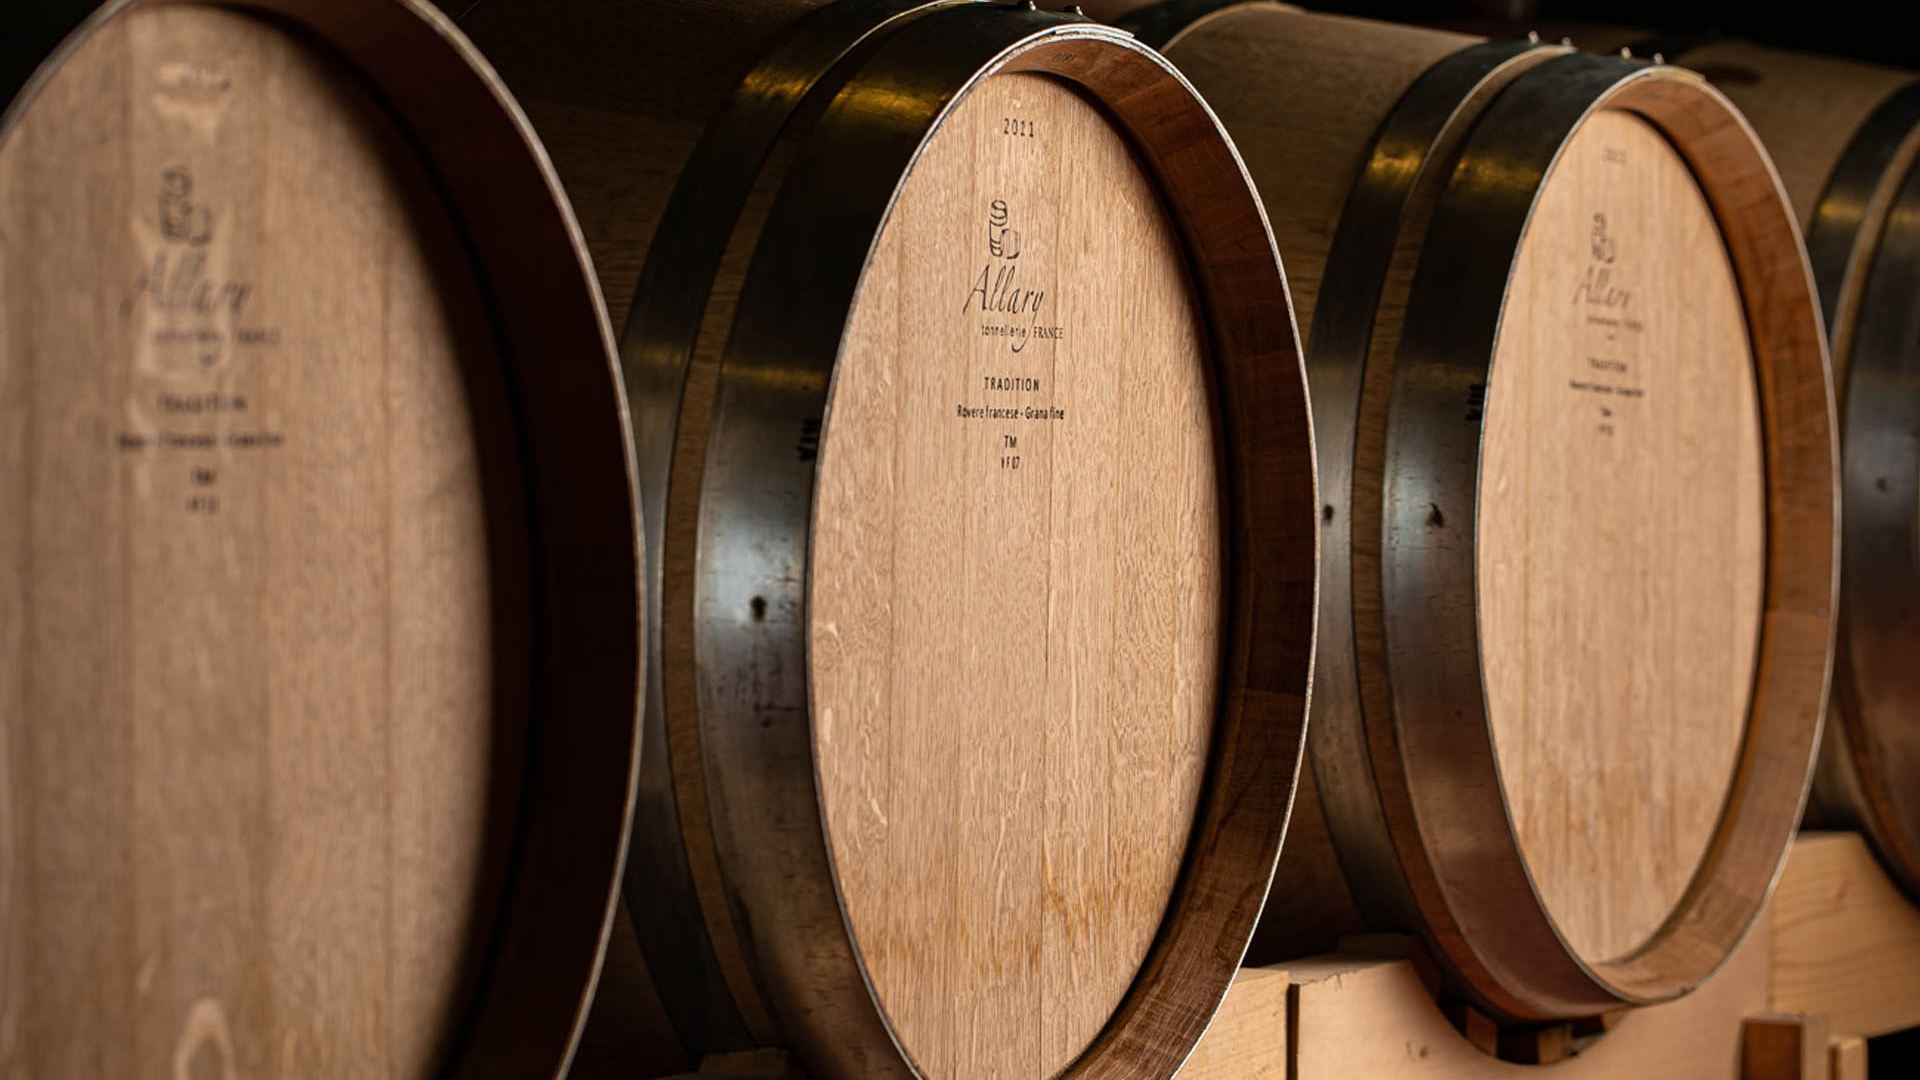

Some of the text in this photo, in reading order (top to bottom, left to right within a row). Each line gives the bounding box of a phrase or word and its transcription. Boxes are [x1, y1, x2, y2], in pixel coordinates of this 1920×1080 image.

[962, 264, 1044, 353] Allary
[1033, 325, 1064, 339] FRANCE
[984, 376, 1039, 392] TRADITION
[957, 404, 985, 419] Rovere
[985, 405, 1019, 420] francese
[1025, 406, 1048, 420] Grana
[1004, 435, 1018, 448] TM
